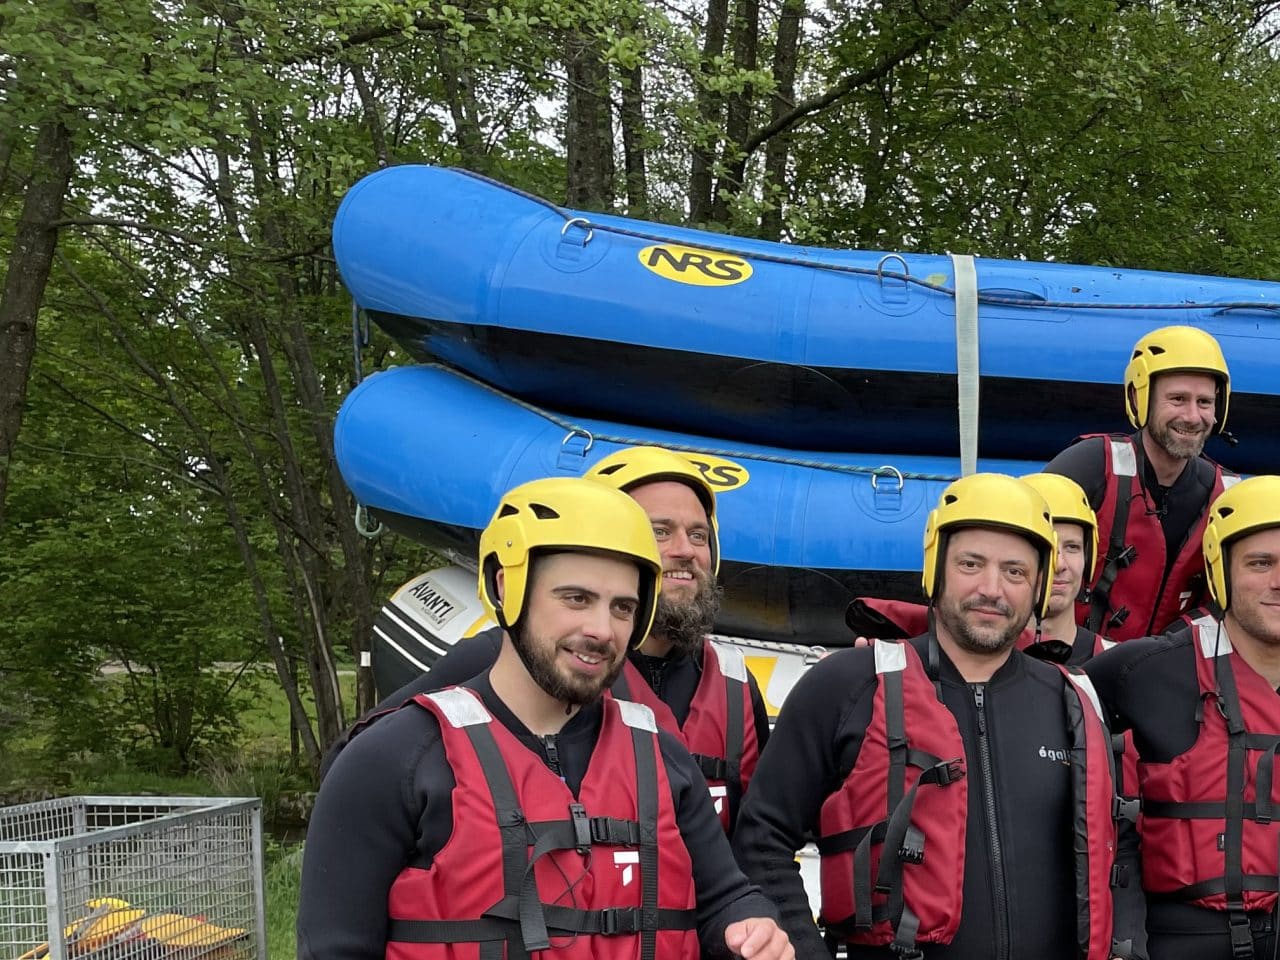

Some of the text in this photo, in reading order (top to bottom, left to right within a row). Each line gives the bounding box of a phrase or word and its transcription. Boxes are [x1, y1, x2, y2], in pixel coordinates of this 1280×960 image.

[647, 247, 745, 281] NRS
[687, 459, 742, 487] RS
[408, 581, 454, 618] AVANTI
